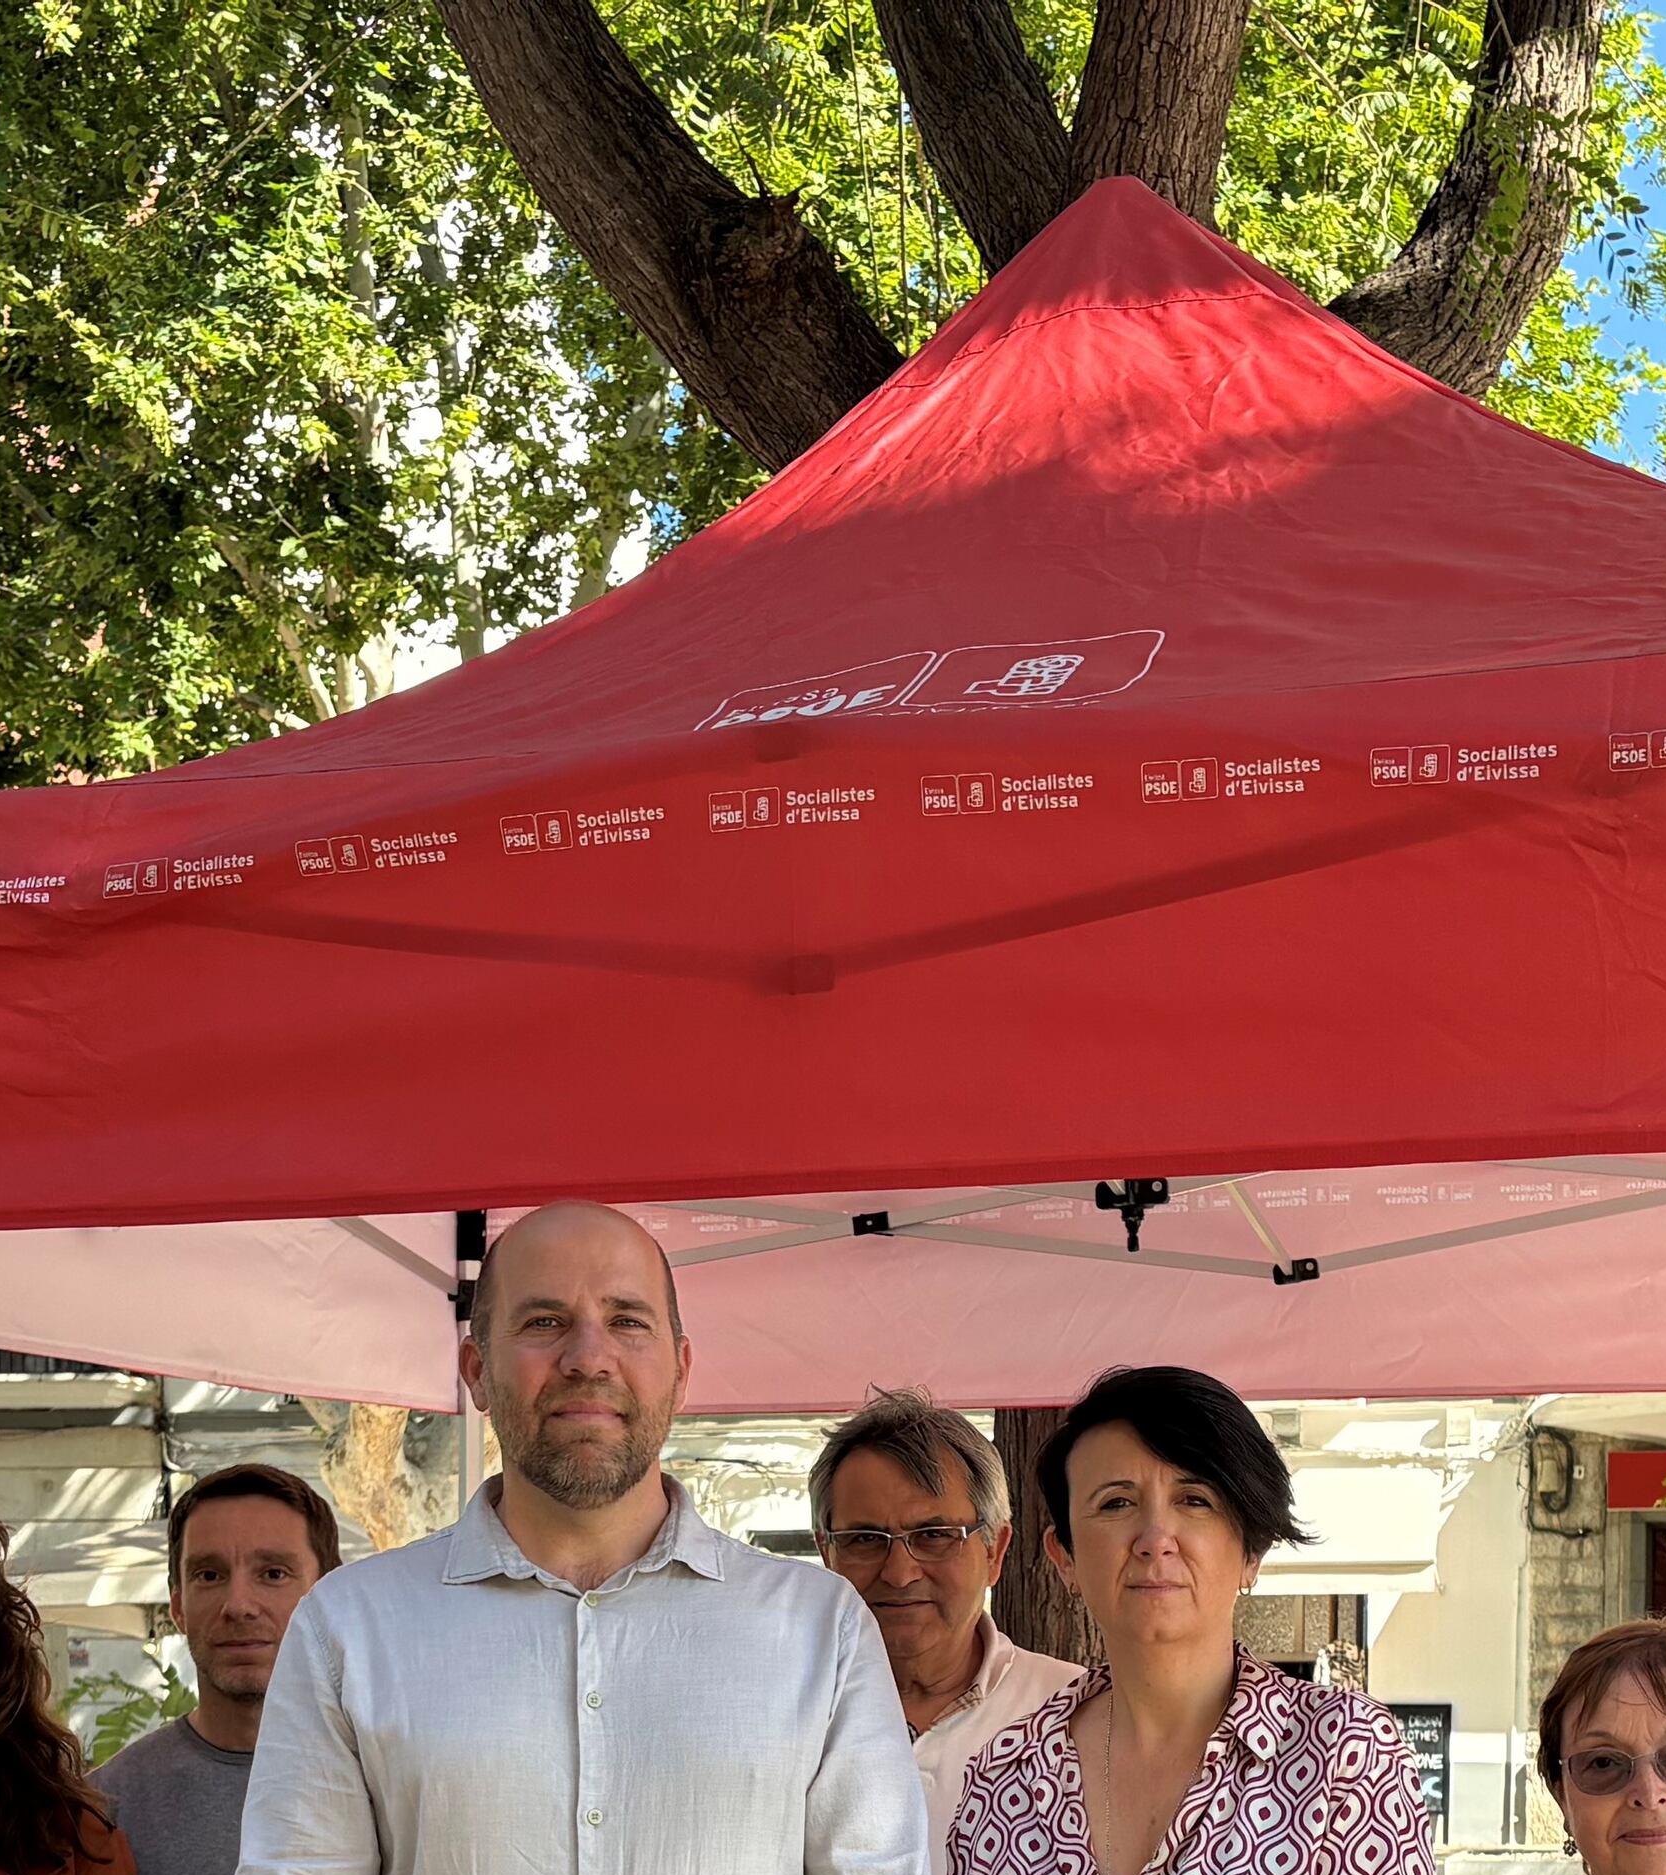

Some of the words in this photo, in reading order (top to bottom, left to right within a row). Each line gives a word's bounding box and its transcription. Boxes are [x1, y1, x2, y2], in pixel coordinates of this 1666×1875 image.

[1457, 741, 1558, 764] Socialistes
[1612, 747, 1646, 764] PSOE
[1224, 756, 1320, 777] Socialistes
[1374, 763, 1407, 780] PSOE
[1001, 773, 1093, 792] Socialistes
[1144, 780, 1178, 796] PSOE
[786, 786, 875, 806] Socialistes
[924, 793, 956, 809] PSOE
[576, 806, 664, 829] Socialistes
[712, 810, 743, 825] PSOE
[371, 831, 458, 852] Socialistes
[506, 832, 535, 848] PSOE
[173, 853, 255, 873] Socialistes
[300, 856, 331, 871] PSOE
[105, 877, 133, 891] PSOE
